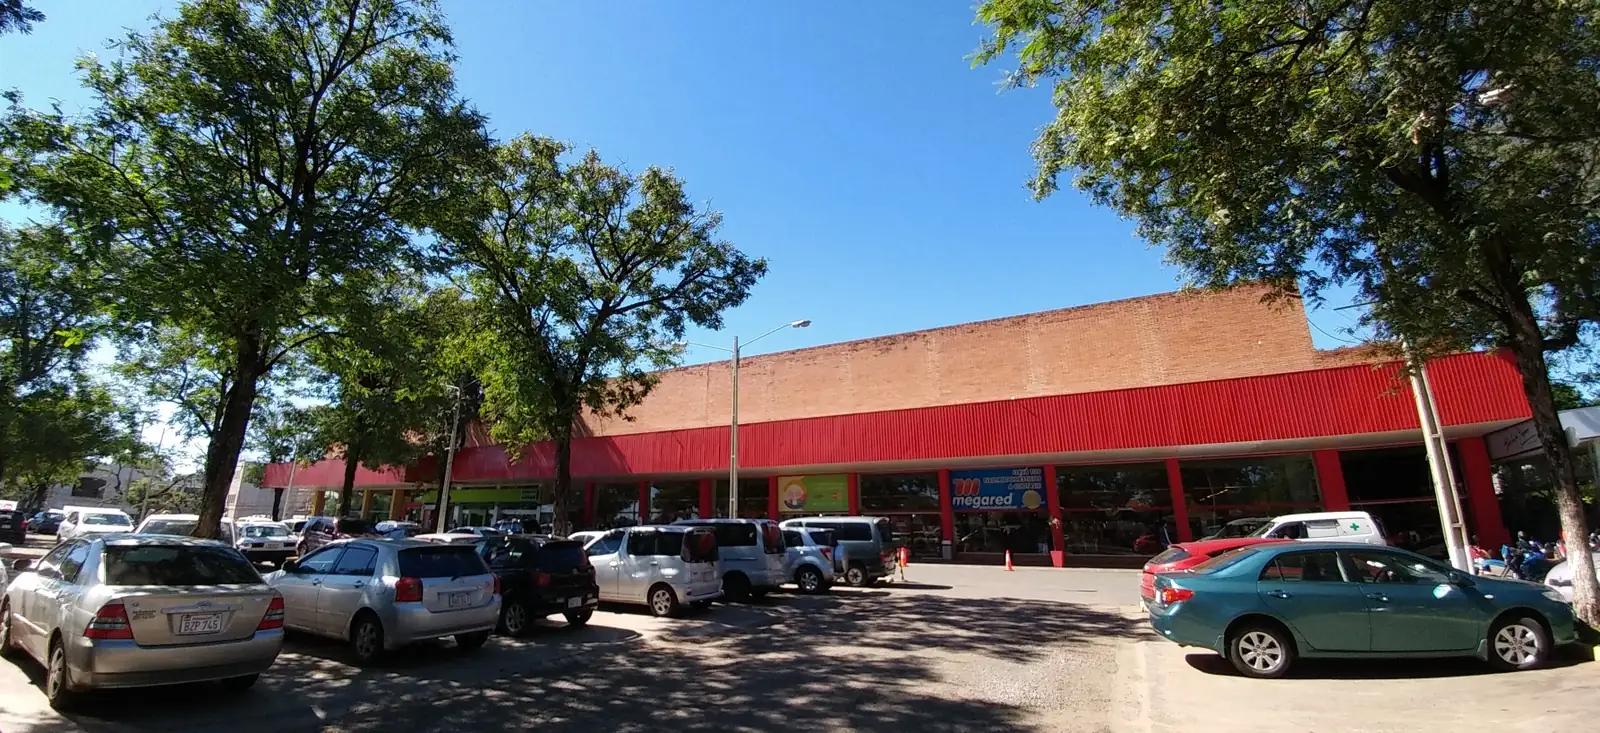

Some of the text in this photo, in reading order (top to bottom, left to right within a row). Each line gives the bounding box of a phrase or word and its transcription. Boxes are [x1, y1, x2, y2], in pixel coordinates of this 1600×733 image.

[952, 492, 1013, 509] megared
[184, 620, 218, 631] BZP 745
